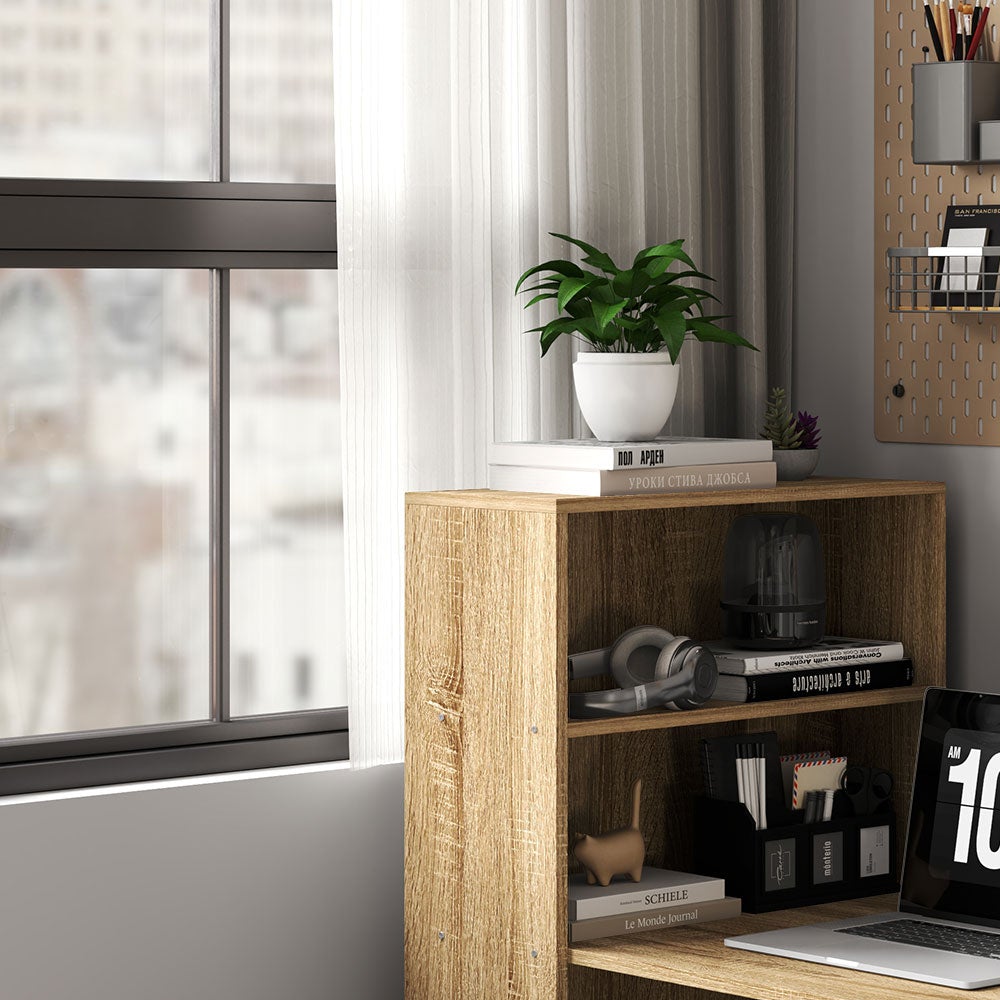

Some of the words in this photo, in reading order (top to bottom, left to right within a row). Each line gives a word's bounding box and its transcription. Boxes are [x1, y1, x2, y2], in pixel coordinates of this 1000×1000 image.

[618, 451, 633, 466] ПОЛ
[640, 449, 665, 467] АРДЕН
[628, 474, 666, 490] УРОКИ
[668, 473, 703, 488] СТИВА
[706, 472, 751, 488] ДЖОБСА
[774, 658, 812, 668] Architects
[812, 656, 829, 665] with
[829, 652, 882, 664] Conversations
[792, 673, 842, 693] architecture
[854, 669, 871, 688] arts
[947, 746, 961, 760] AM
[644, 889, 689, 905] SCHIELE
[625, 919, 635, 930] Le
[637, 915, 666, 929] Monde
[668, 909, 699, 926] Journal
